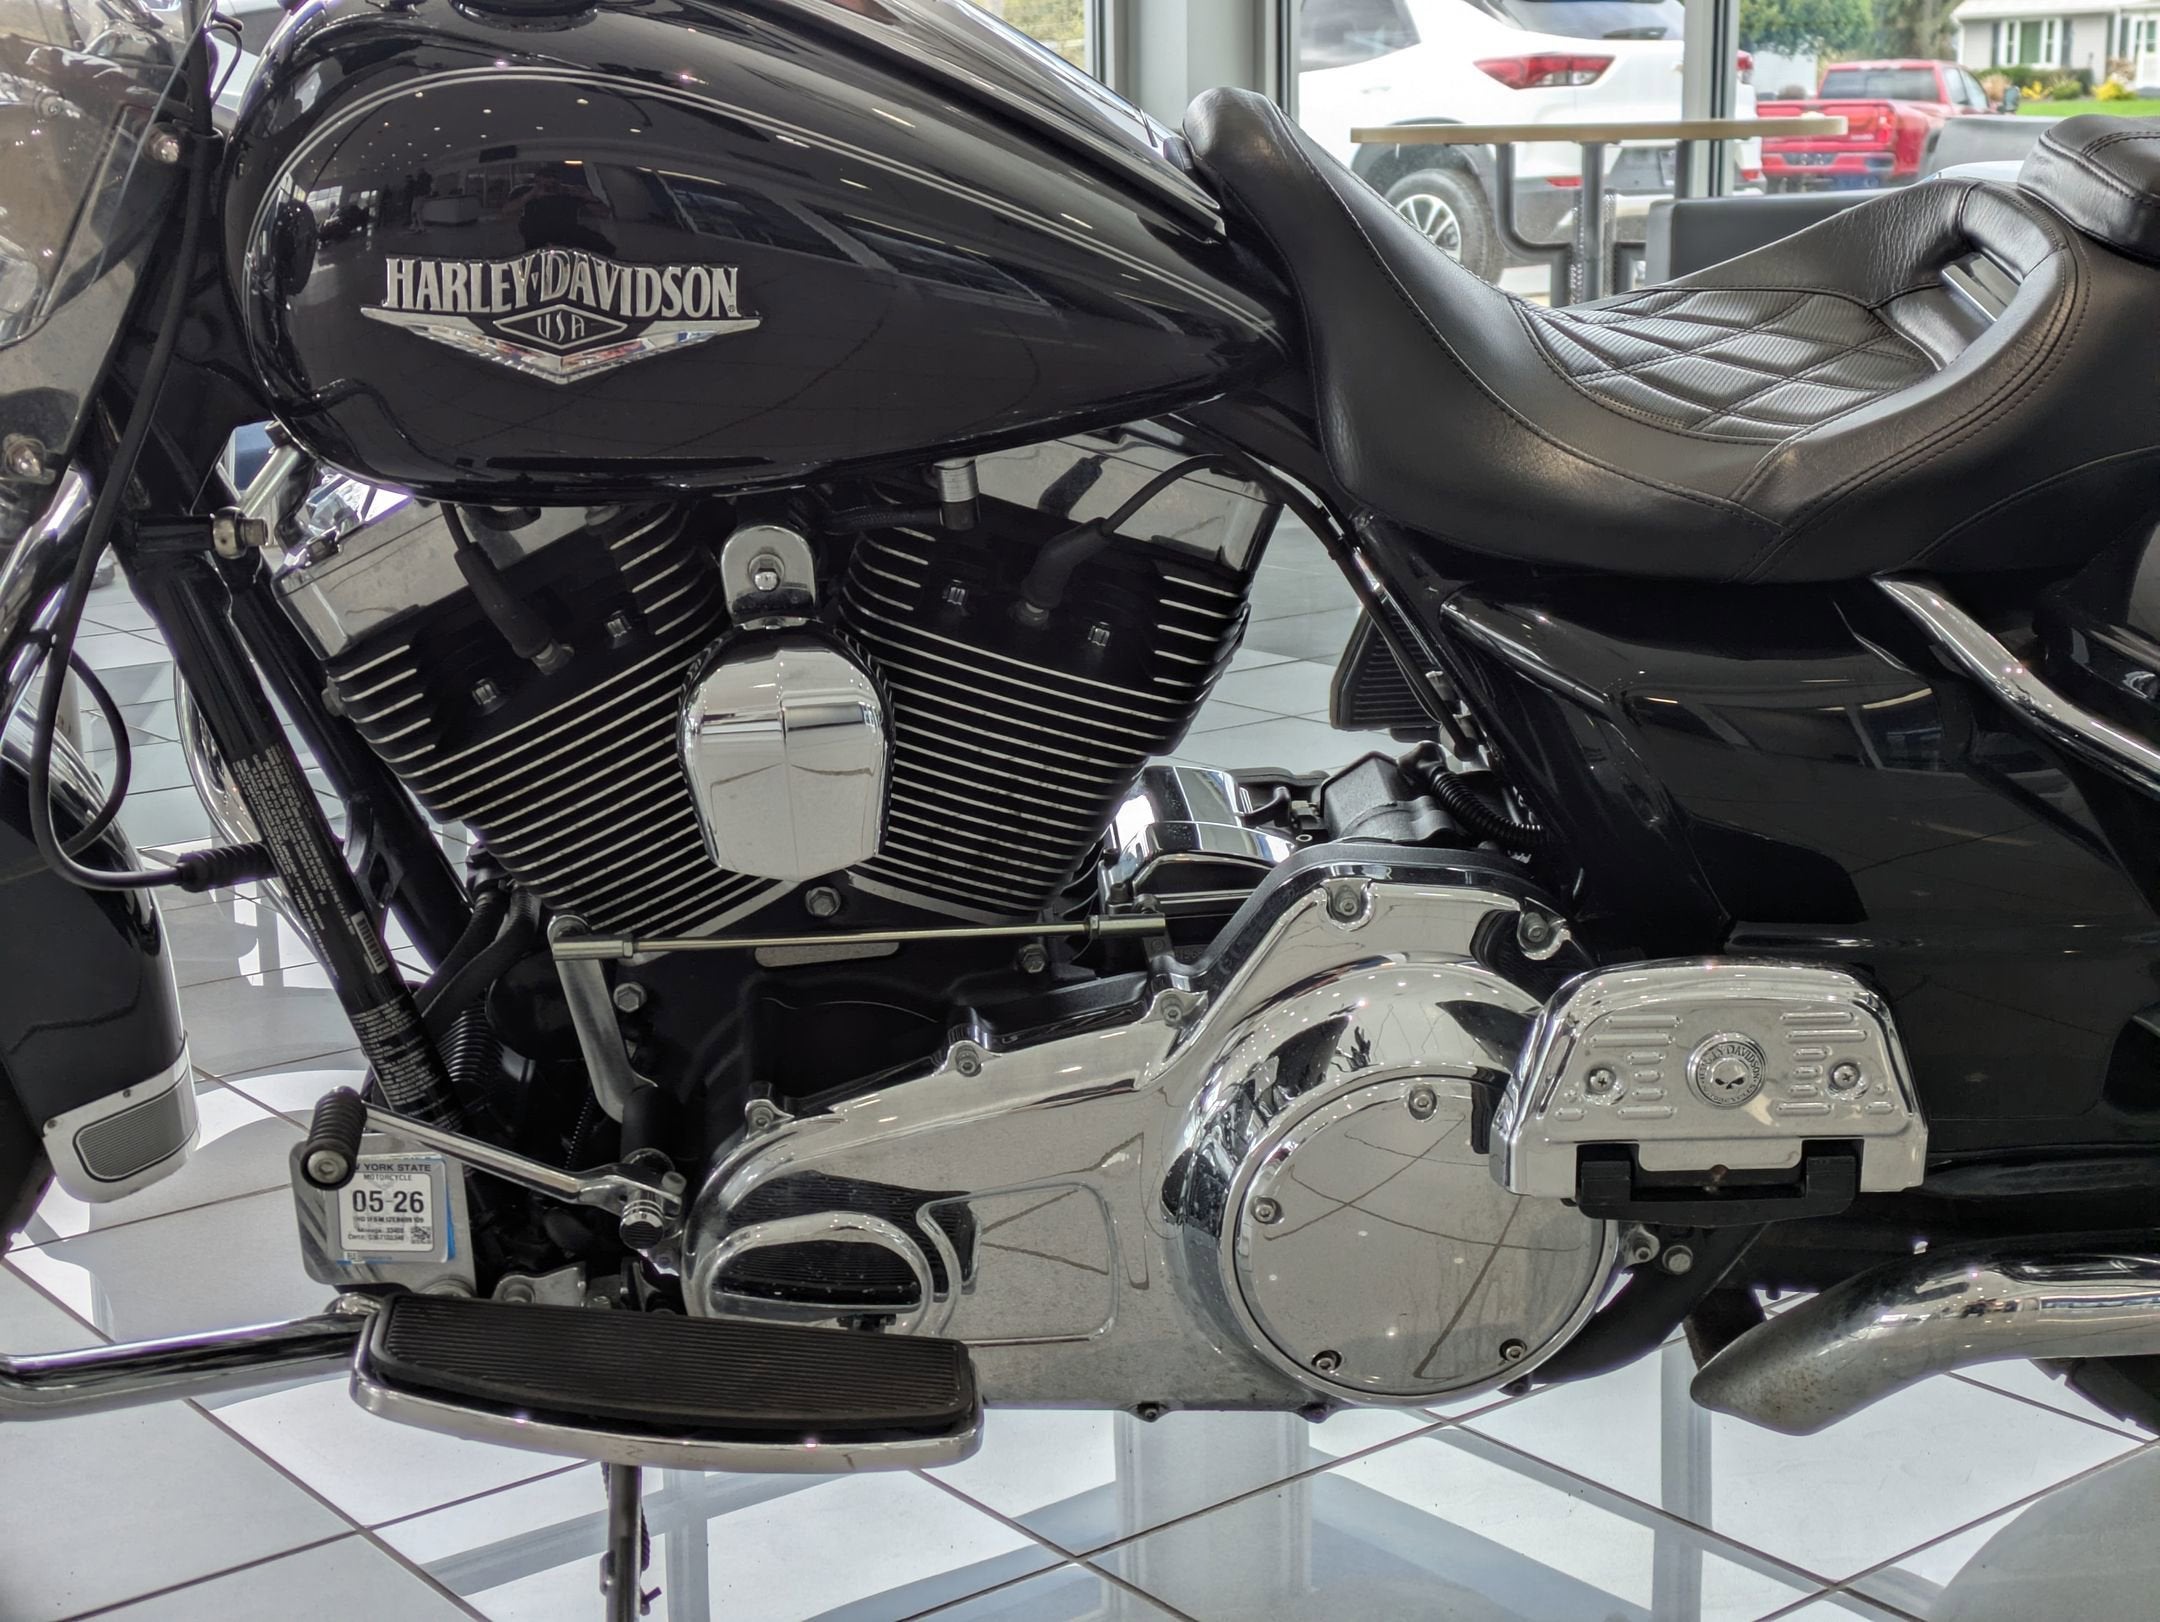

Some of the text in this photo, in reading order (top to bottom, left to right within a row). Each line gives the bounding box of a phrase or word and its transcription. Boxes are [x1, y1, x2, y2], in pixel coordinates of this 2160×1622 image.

[536, 312, 585, 343] USA
[363, 1163, 394, 1171] YORK
[397, 1164, 432, 1172] STATE
[363, 1173, 412, 1181] MOTORCYCLE
